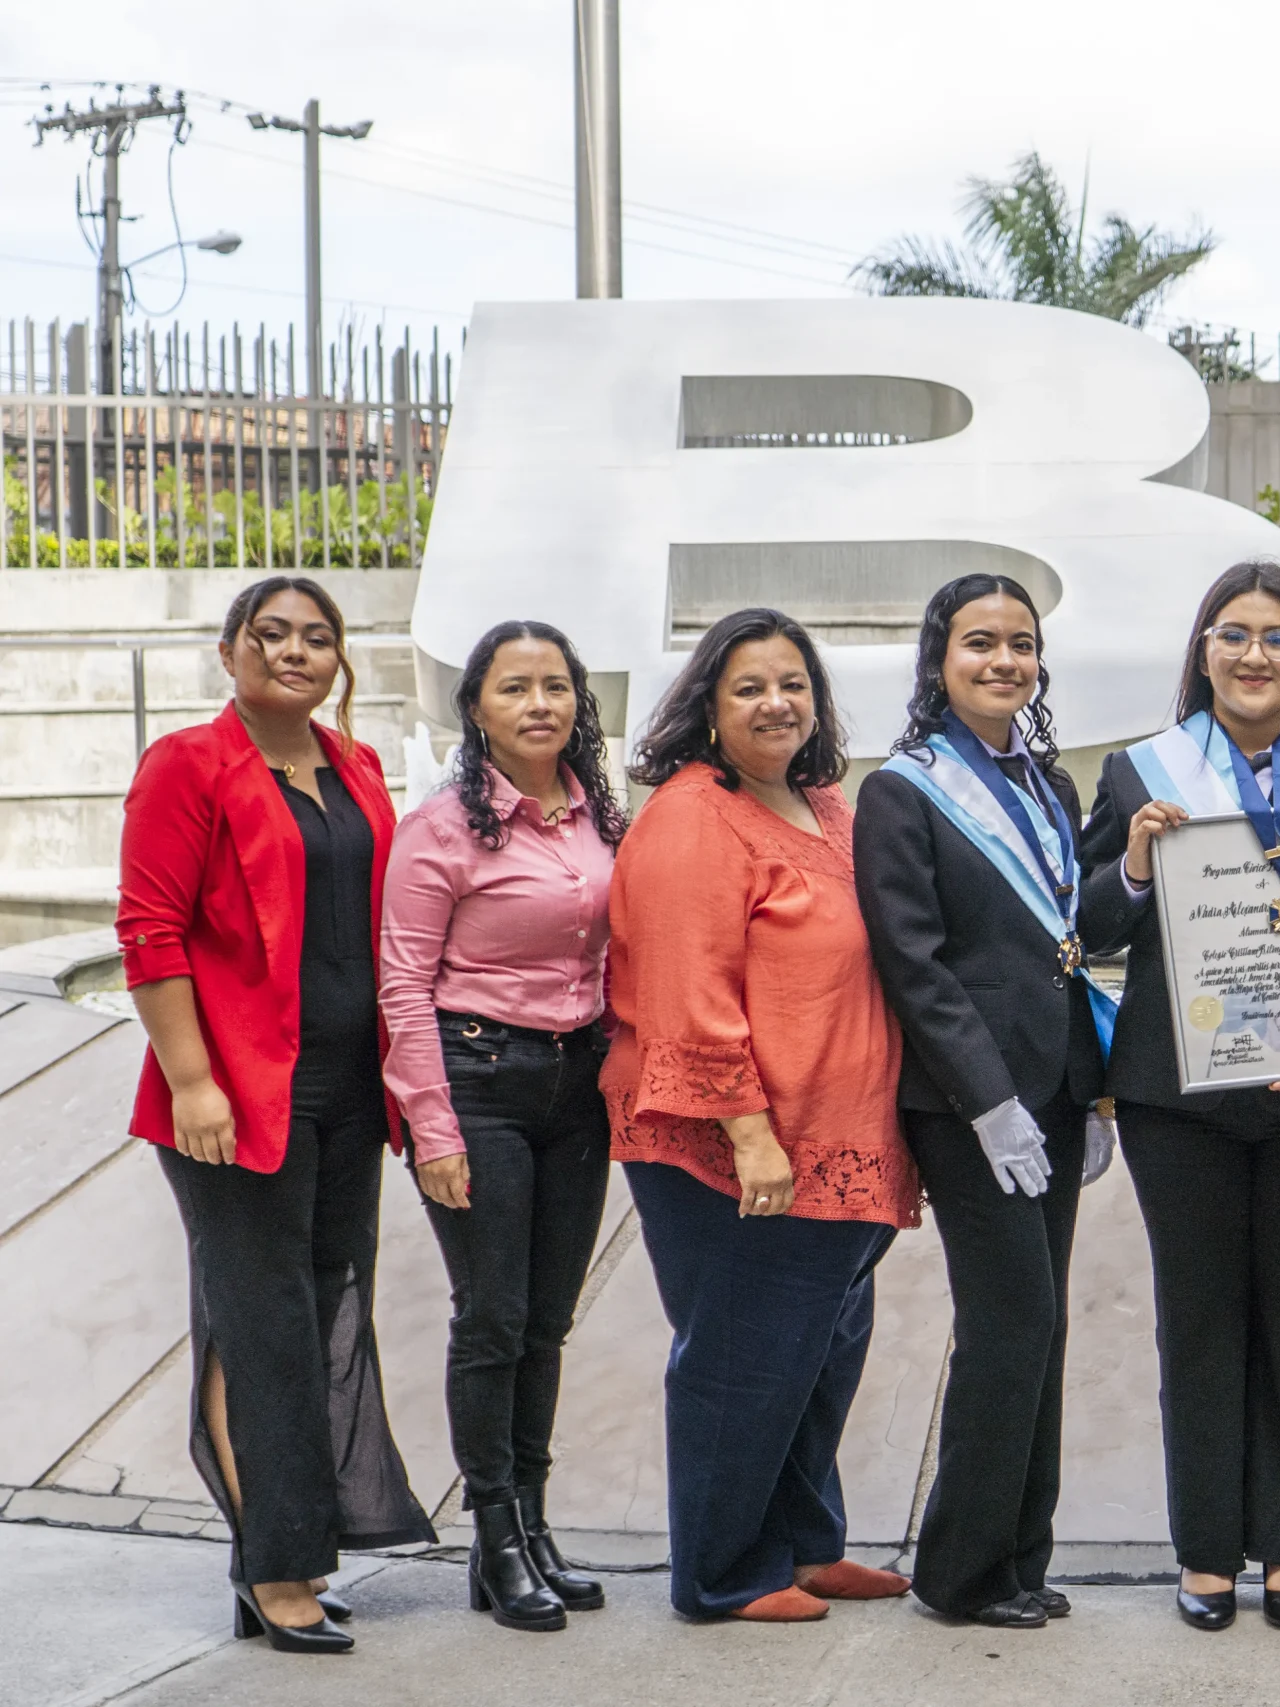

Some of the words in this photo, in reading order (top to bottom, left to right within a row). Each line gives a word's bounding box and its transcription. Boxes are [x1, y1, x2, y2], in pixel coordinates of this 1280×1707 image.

[1202, 864, 1241, 879] Programa
[1255, 879, 1269, 889] A
[1189, 904, 1222, 921] Nadia
[1222, 901, 1268, 919] Alejandr
[1238, 926, 1268, 937] Alumna
[1202, 949, 1227, 962] Colegio
